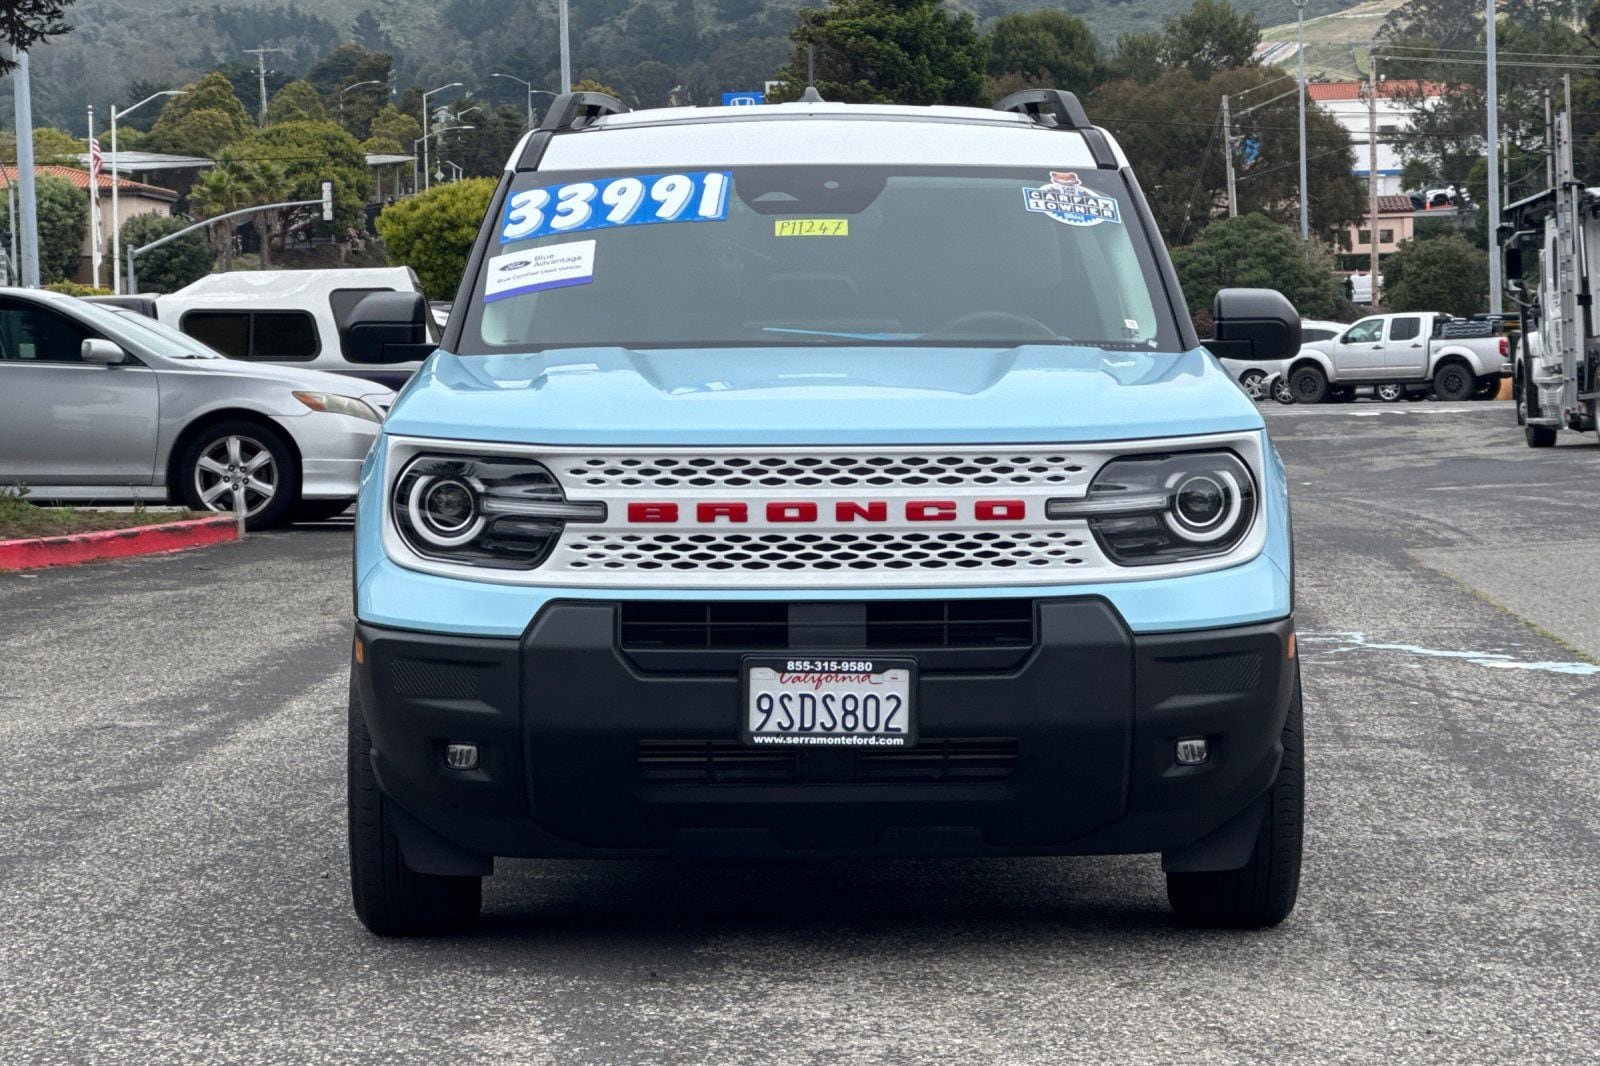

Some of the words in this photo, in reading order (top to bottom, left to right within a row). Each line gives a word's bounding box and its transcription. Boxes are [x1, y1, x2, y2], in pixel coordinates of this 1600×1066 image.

[503, 172, 730, 239] 33991
[1030, 191, 1112, 209] CARFAX
[1047, 203, 1113, 218] OWNER
[780, 221, 844, 235] P11247
[533, 256, 582, 267] Advantage
[627, 500, 1025, 523] BRONCO
[787, 661, 872, 671] 855-315-9580
[755, 692, 902, 732] 9SDS802
[753, 735, 904, 745] www.serramonteford.com
